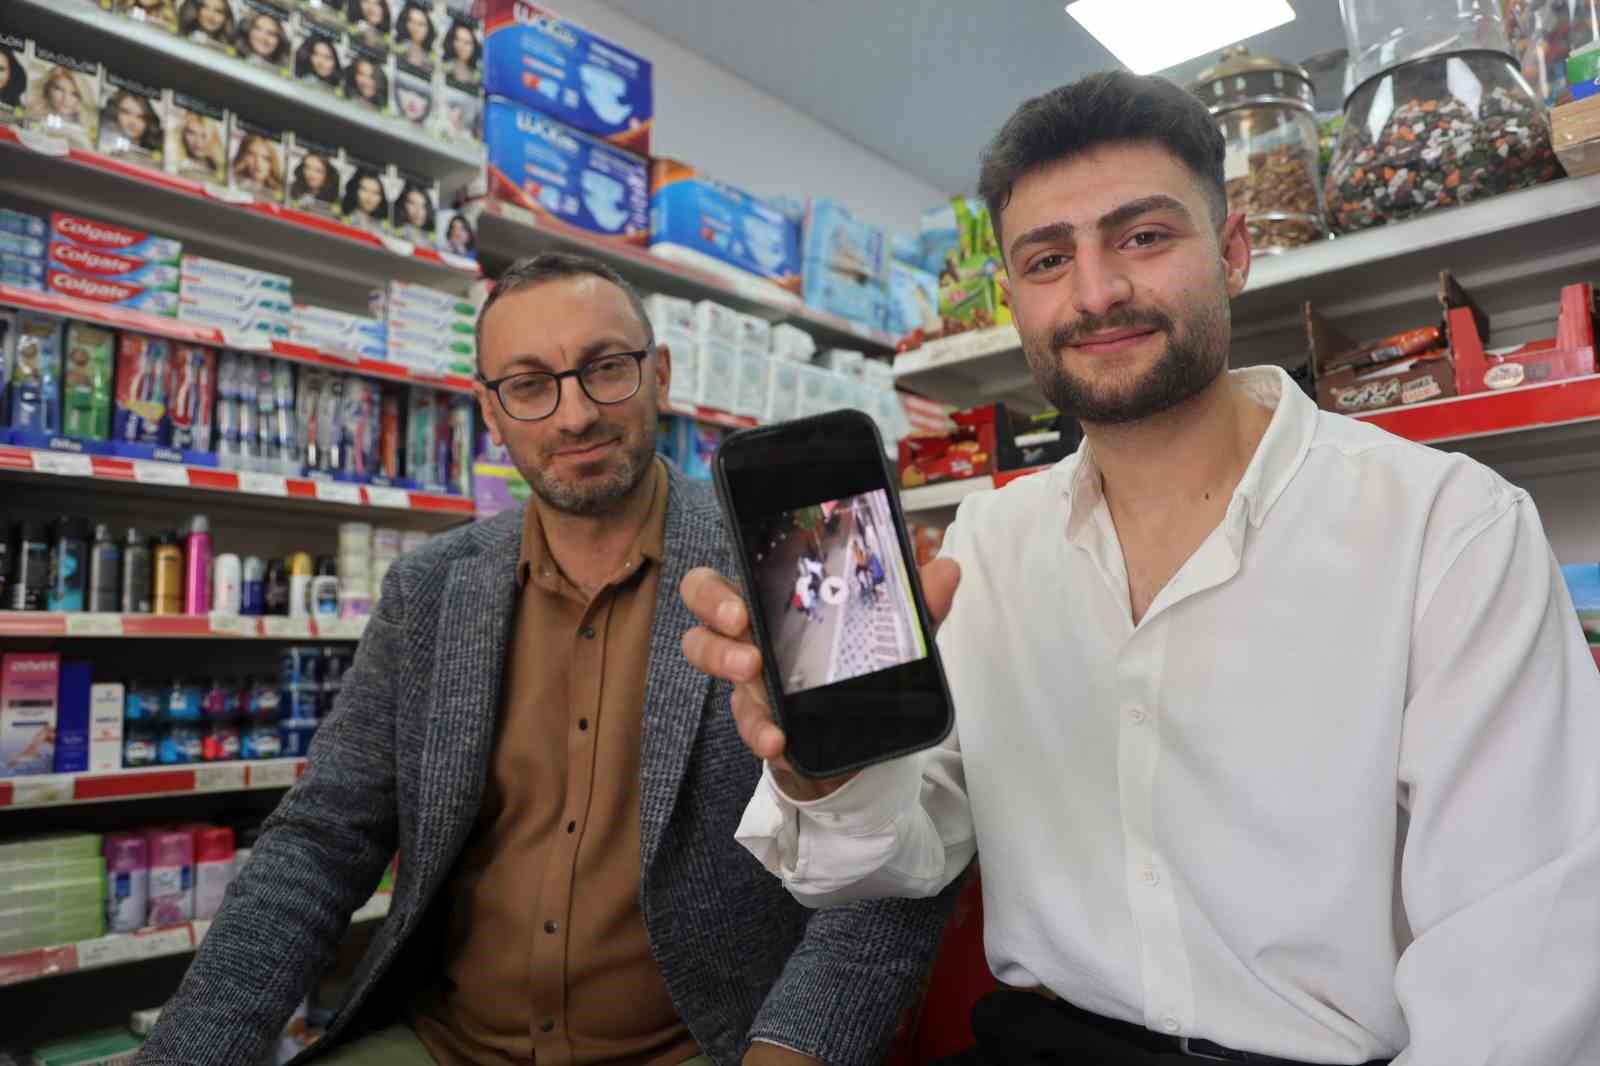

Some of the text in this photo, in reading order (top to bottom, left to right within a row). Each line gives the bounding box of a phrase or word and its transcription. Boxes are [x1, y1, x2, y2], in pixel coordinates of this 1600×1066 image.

[58, 218, 135, 244] Colgate
[56, 244, 133, 272] Colgate
[53, 273, 130, 299] Colgate
